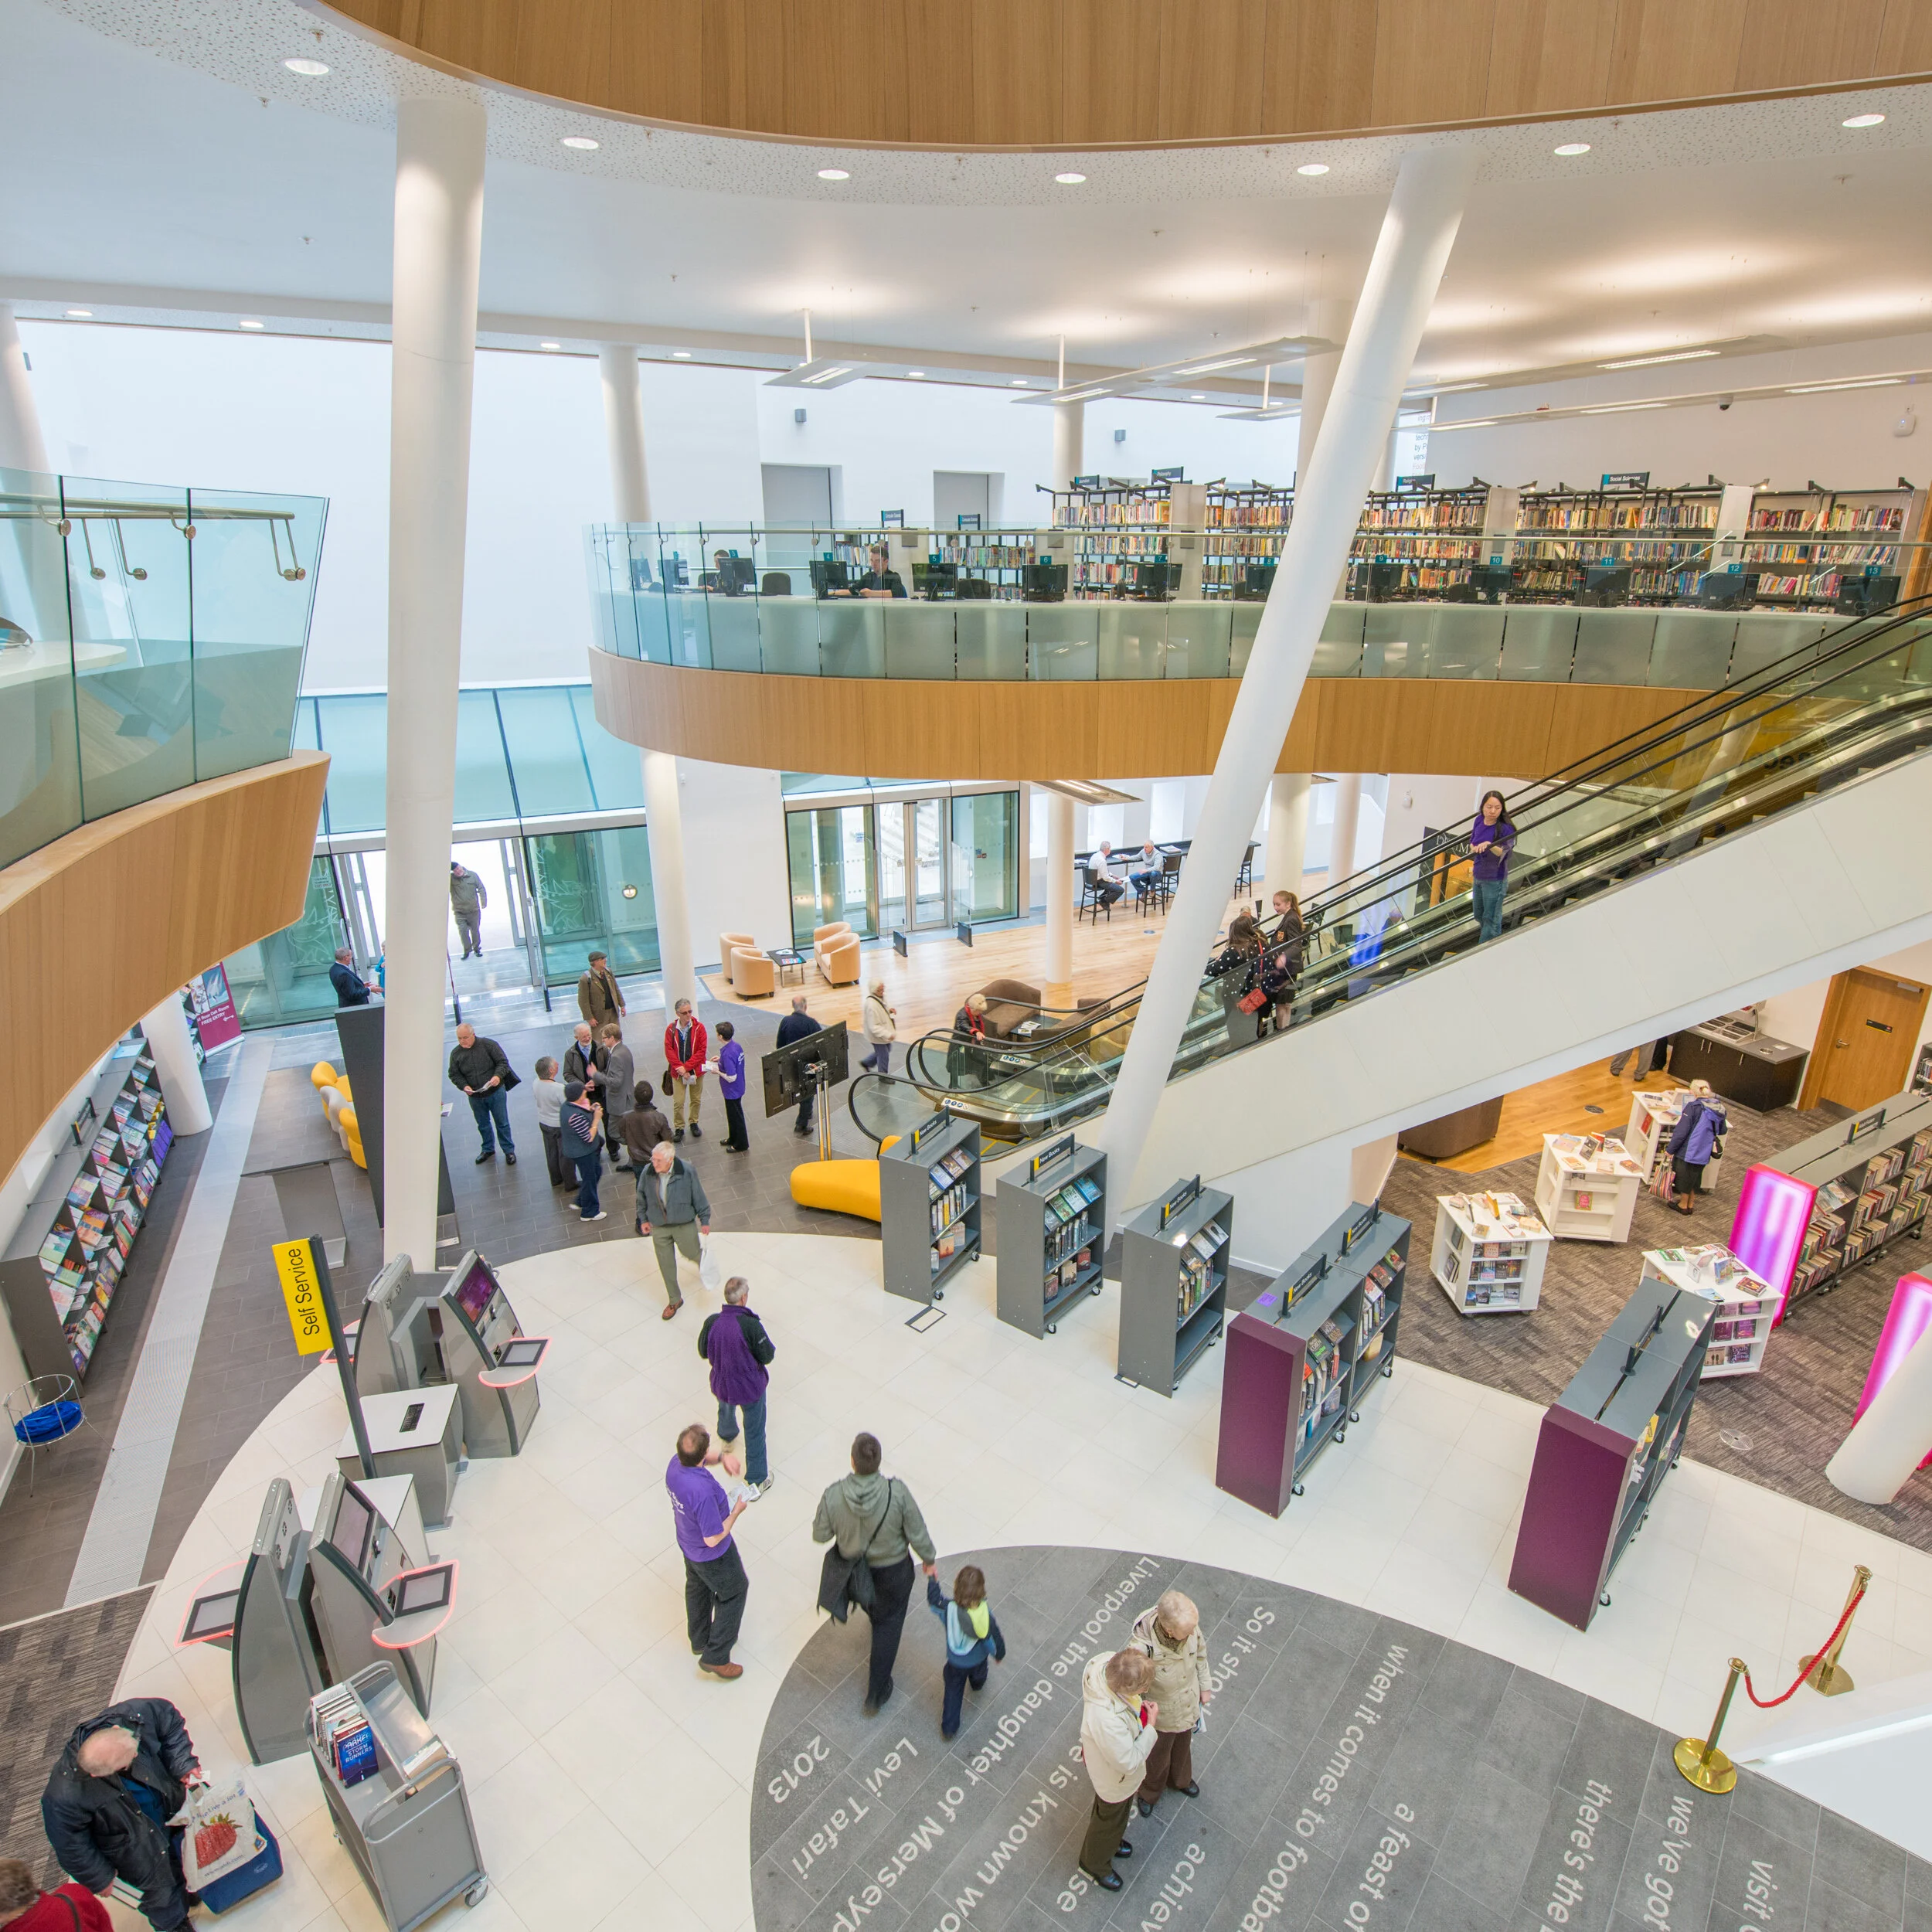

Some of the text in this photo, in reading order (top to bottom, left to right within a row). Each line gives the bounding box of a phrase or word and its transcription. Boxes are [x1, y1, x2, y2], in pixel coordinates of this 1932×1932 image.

[212, 1012, 226, 1021] ENTRY
[927, 1120, 937, 1131] Books
[1039, 1146, 1060, 1164] New Books
[287, 1248, 320, 1335] Self Service
[1293, 1272, 1312, 1293] New Books
[1050, 1556, 1161, 1678] Liverpool the
[1246, 1606, 1275, 1634] So
[1232, 1634, 1257, 1655] it
[345, 1747, 372, 1763] RUNNERS
[348, 1743, 369, 1757] STORM
[964, 1679, 1053, 1786] daughter
[1295, 1644, 1409, 1838] when it comes to
[767, 1735, 830, 1804] 2013
[1049, 1764, 1079, 1789] is
[791, 1736, 919, 1880] Levi Tafari
[937, 1786, 964, 1823] of
[1393, 1802, 1415, 1823] a
[977, 1791, 1059, 1885] known
[1547, 1779, 1614, 1924] there's the
[1359, 1825, 1411, 1901] feast
[1643, 1795, 1694, 1932] we've got
[1743, 1860, 1779, 1920] visit
